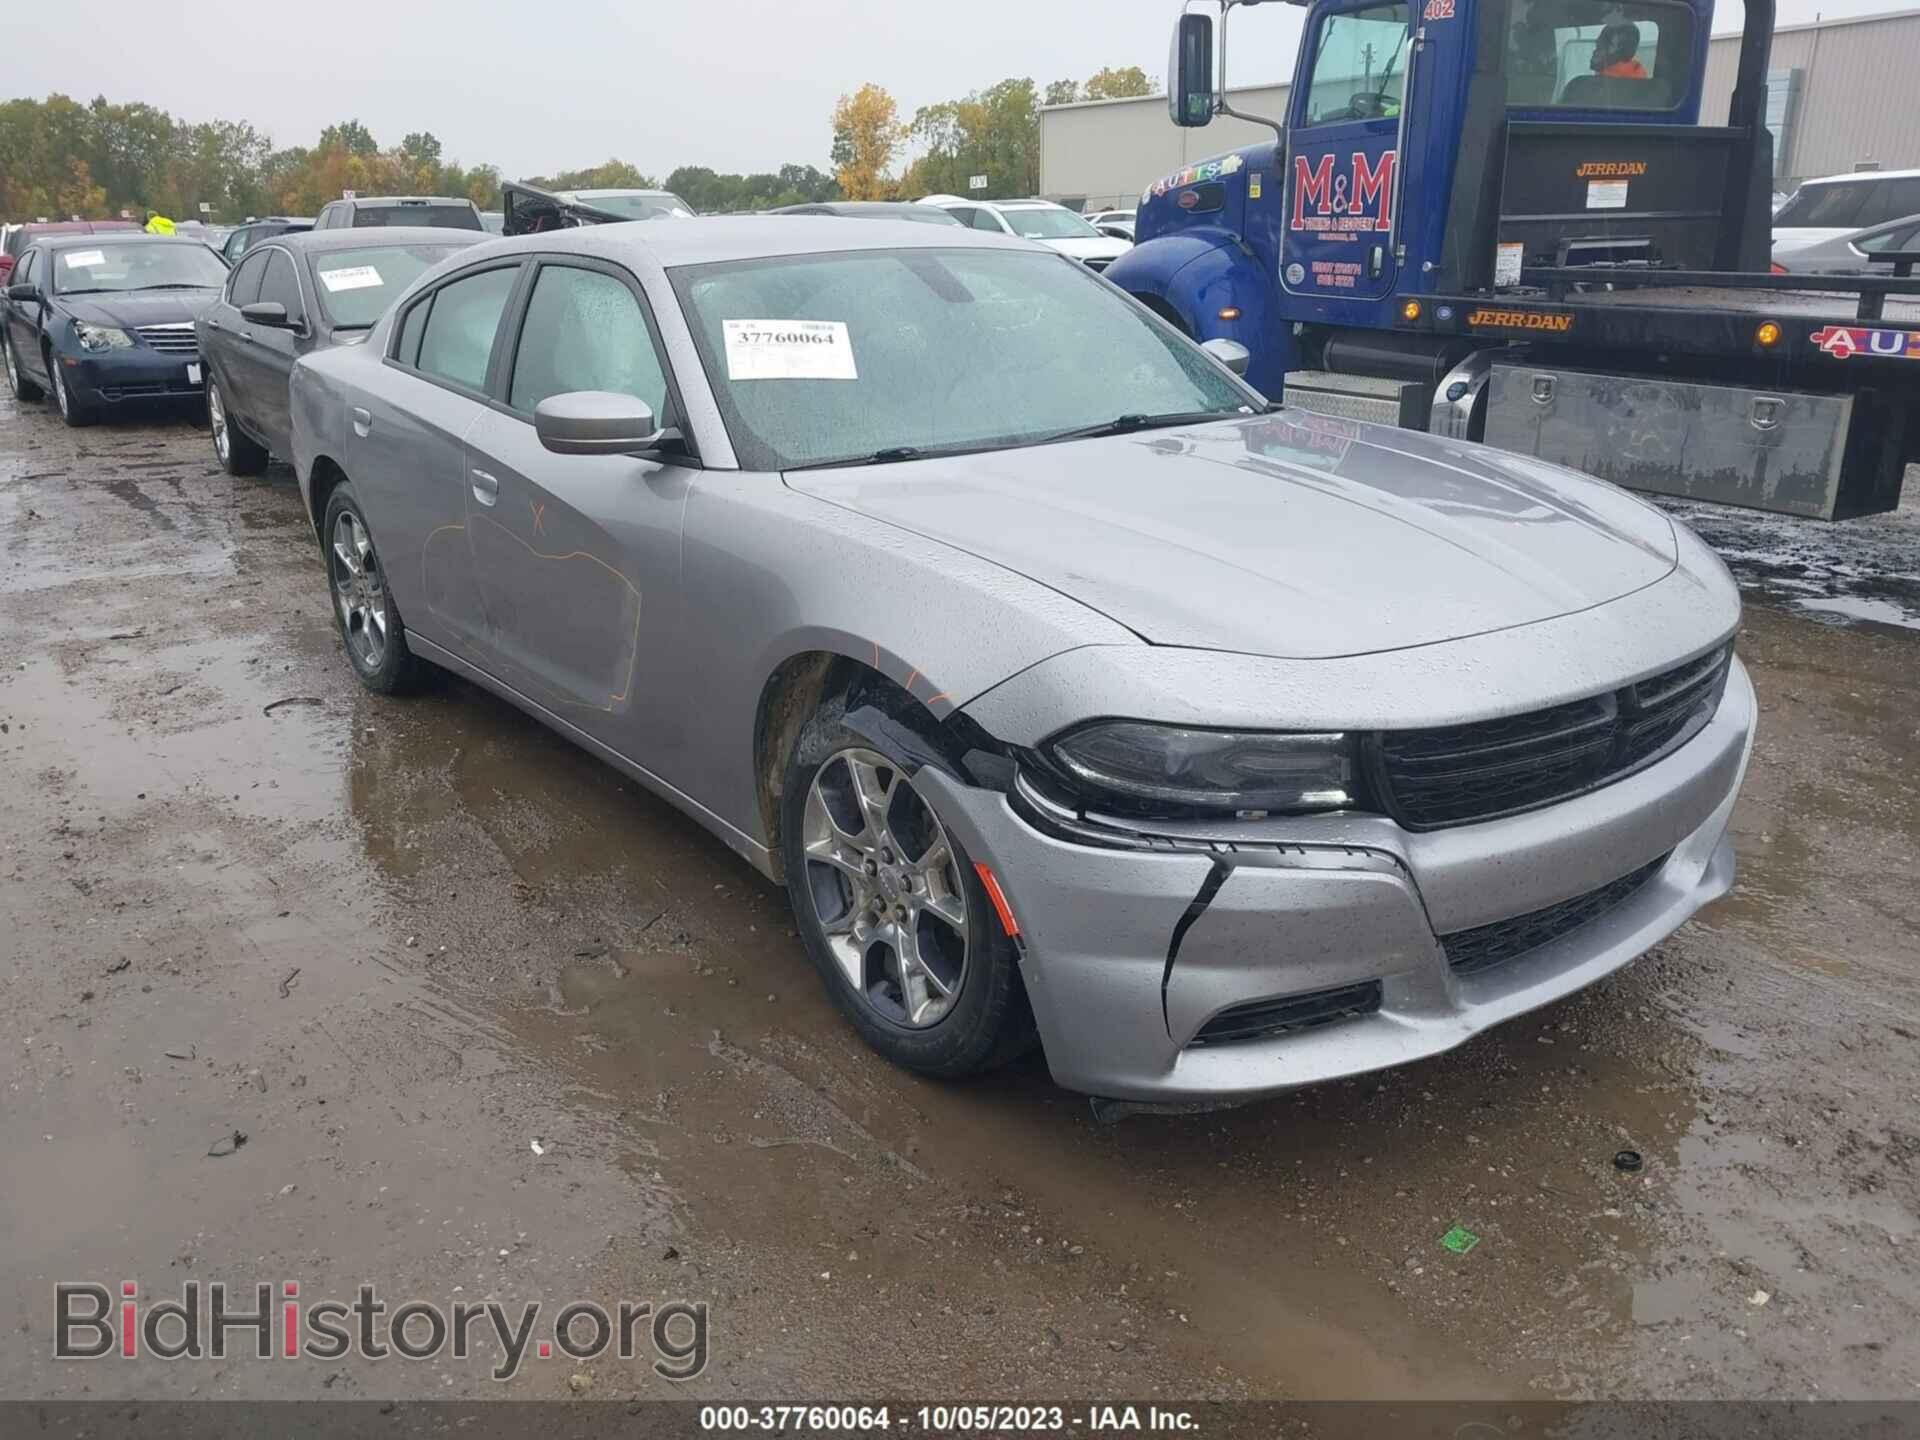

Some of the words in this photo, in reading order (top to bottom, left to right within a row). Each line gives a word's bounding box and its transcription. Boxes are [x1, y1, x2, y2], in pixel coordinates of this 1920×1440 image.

[1424, 0, 1455, 20] 402
[1291, 150, 1397, 231] M&M
[738, 332, 834, 344] 37760064
